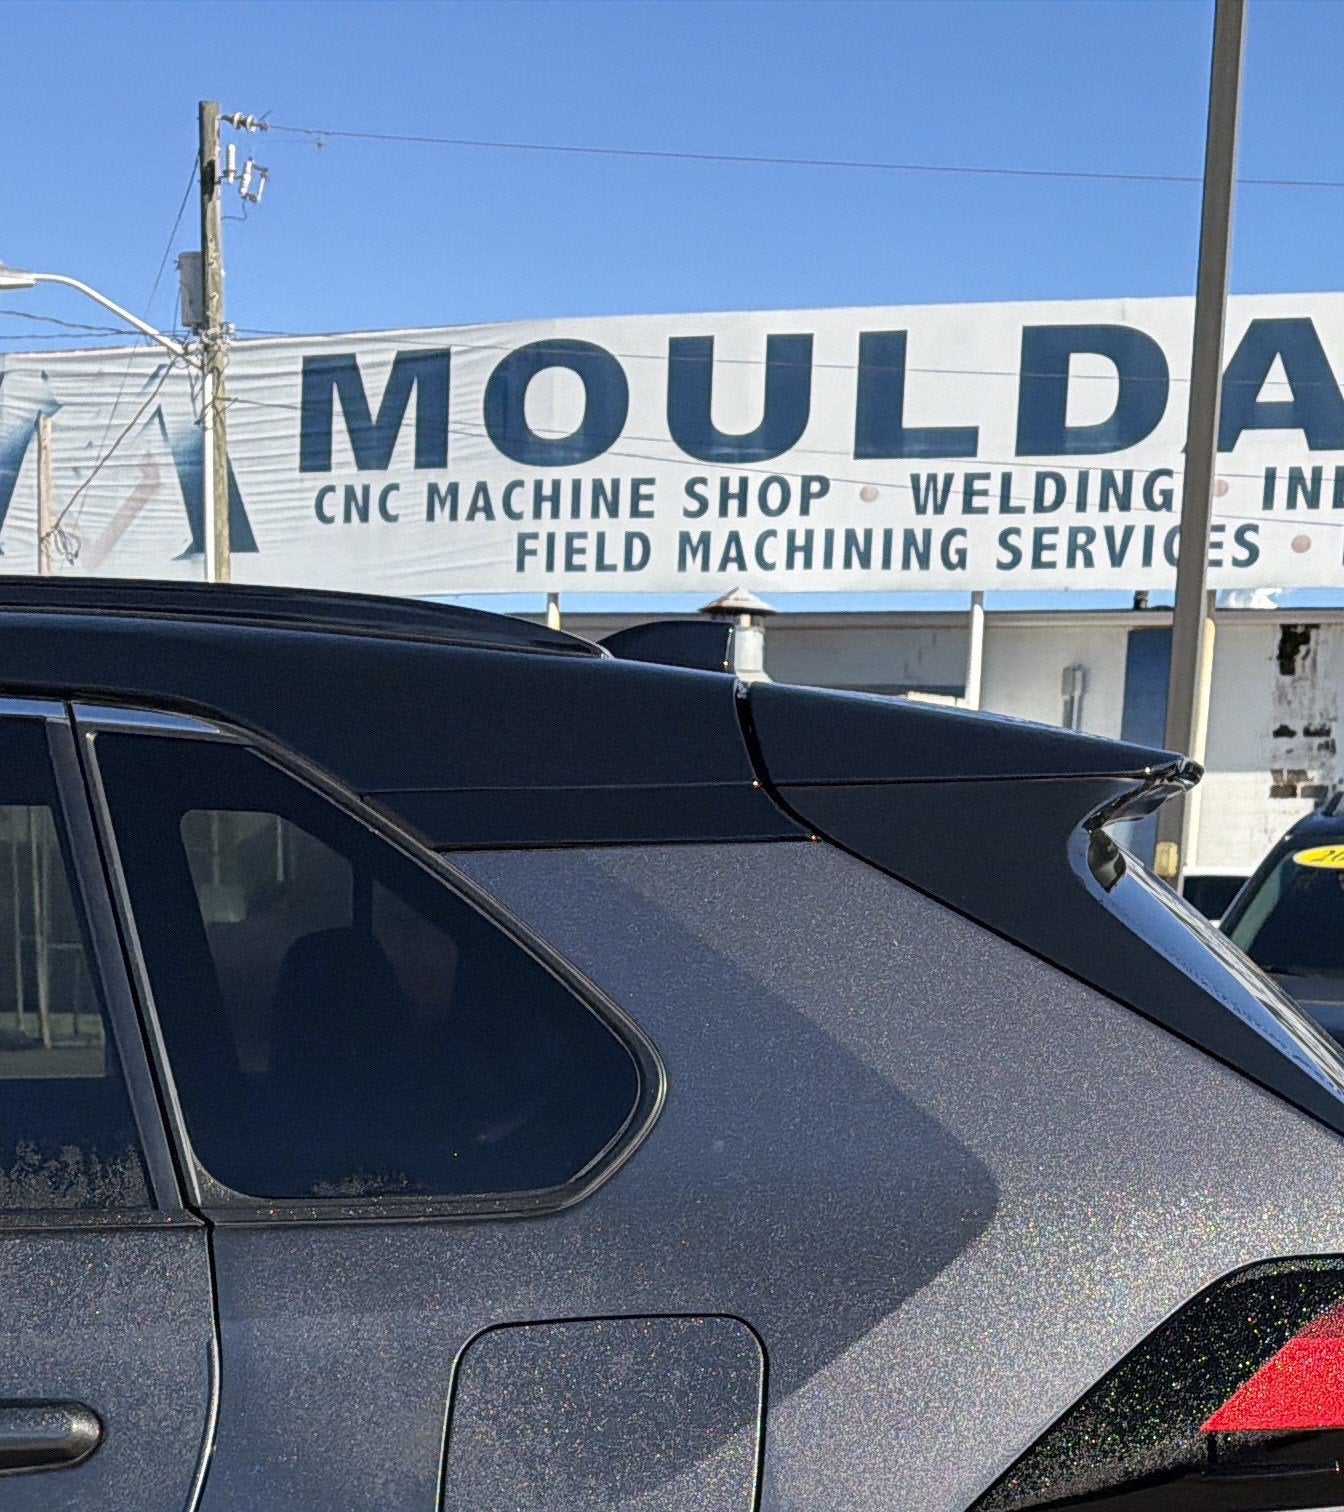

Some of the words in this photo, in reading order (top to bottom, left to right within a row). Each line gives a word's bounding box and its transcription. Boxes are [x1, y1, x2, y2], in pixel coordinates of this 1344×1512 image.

[315, 483, 399, 524] CNC
[427, 478, 655, 521] MACHINE
[684, 476, 829, 518] SHOP
[911, 469, 1173, 515] WELDING
[517, 532, 650, 572] FIELD
[679, 528, 966, 571] MACHINING
